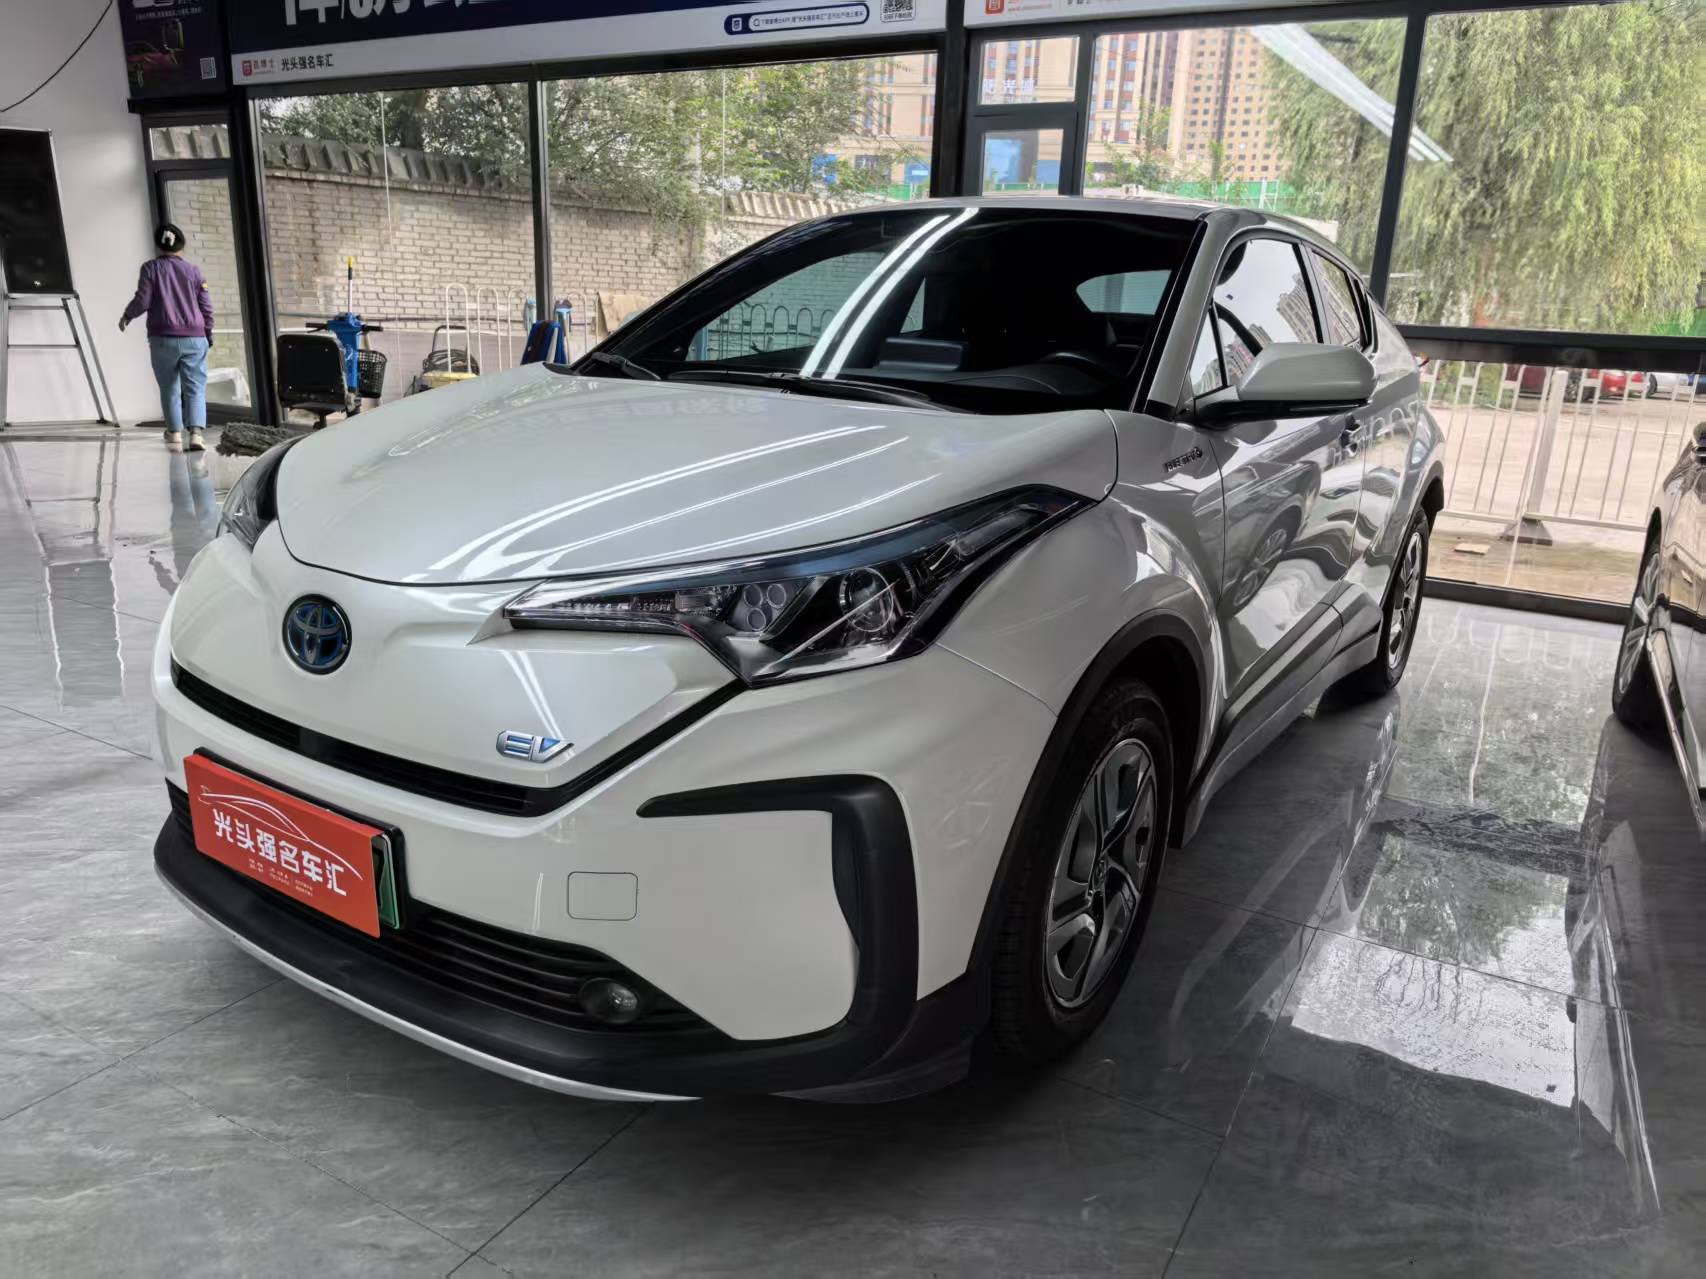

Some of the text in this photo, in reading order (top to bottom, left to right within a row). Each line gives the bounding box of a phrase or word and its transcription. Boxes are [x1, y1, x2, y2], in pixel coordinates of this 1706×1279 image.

[281, 54, 334, 71] 光头强名车汇
[496, 730, 575, 763] EV
[213, 808, 347, 897] 光头强名车汇
